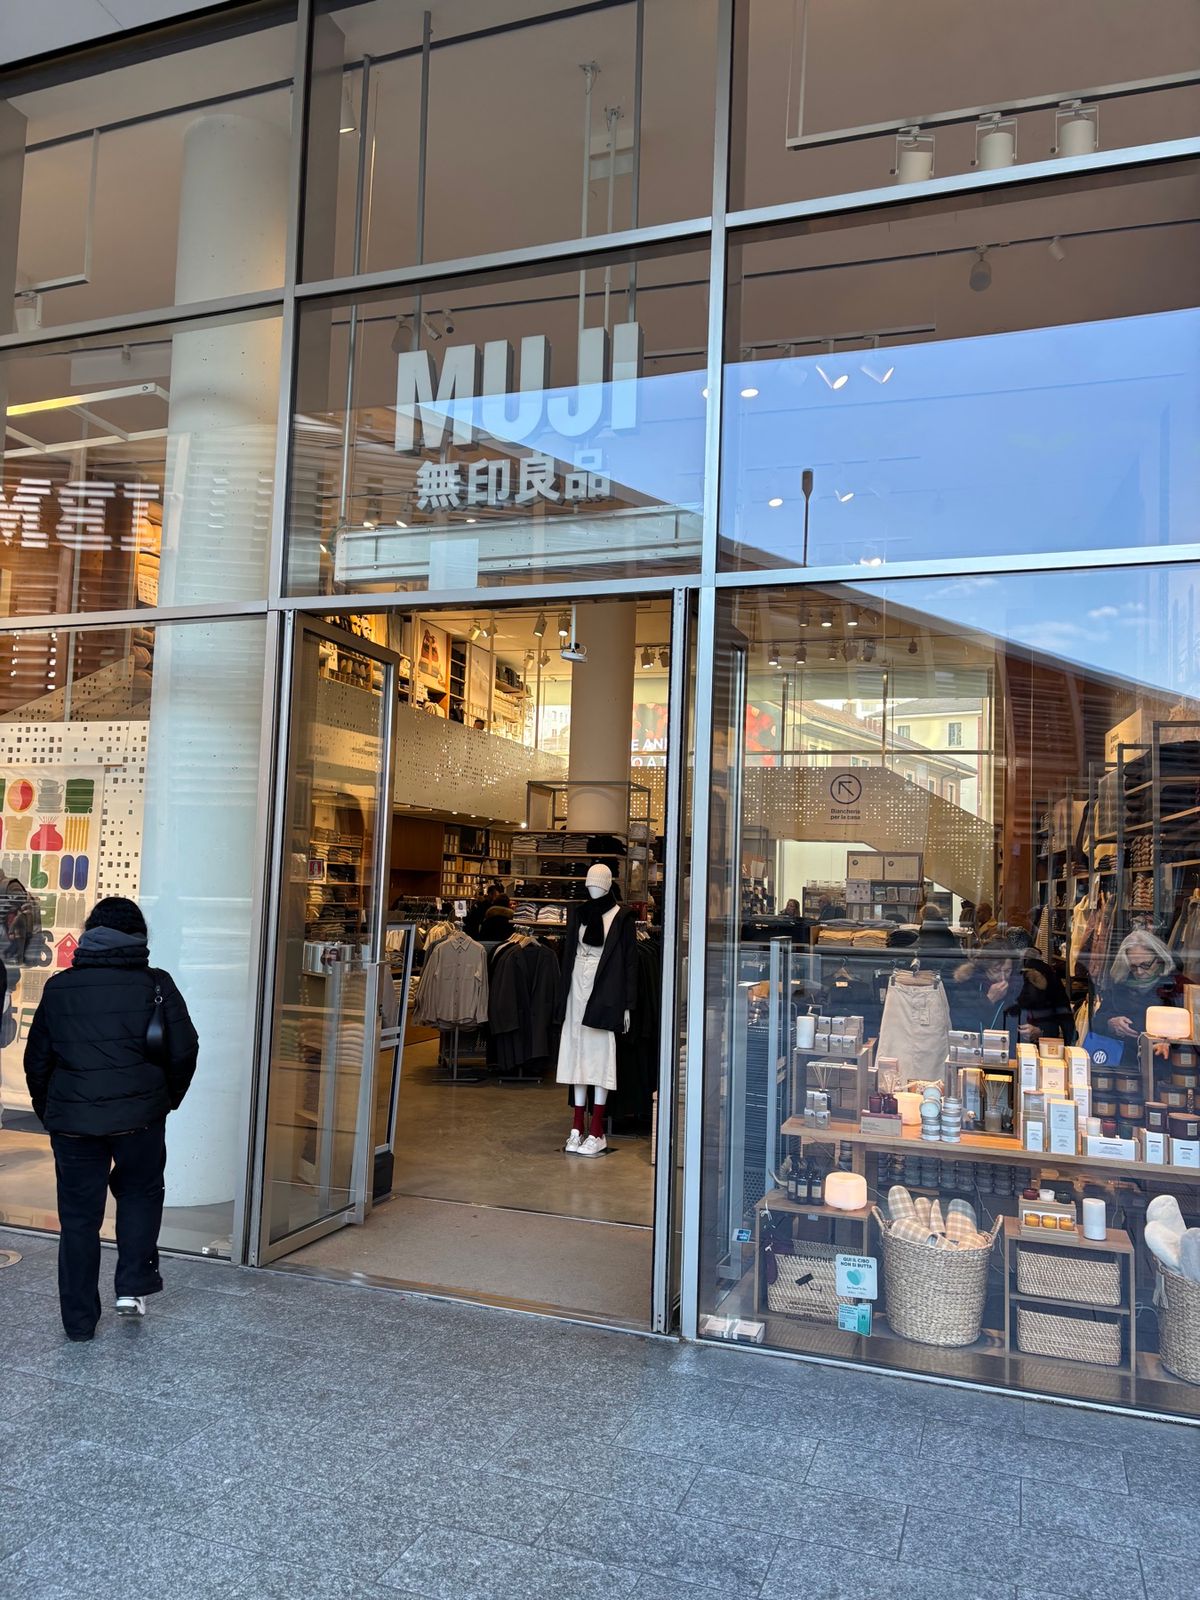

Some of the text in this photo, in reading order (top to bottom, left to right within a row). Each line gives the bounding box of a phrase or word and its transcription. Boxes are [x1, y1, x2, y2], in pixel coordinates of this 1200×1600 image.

[395, 322, 640, 451] MUJI
[416, 448, 611, 511] 無印良品
[784, 1253, 833, 1263] ATTENZIONE
